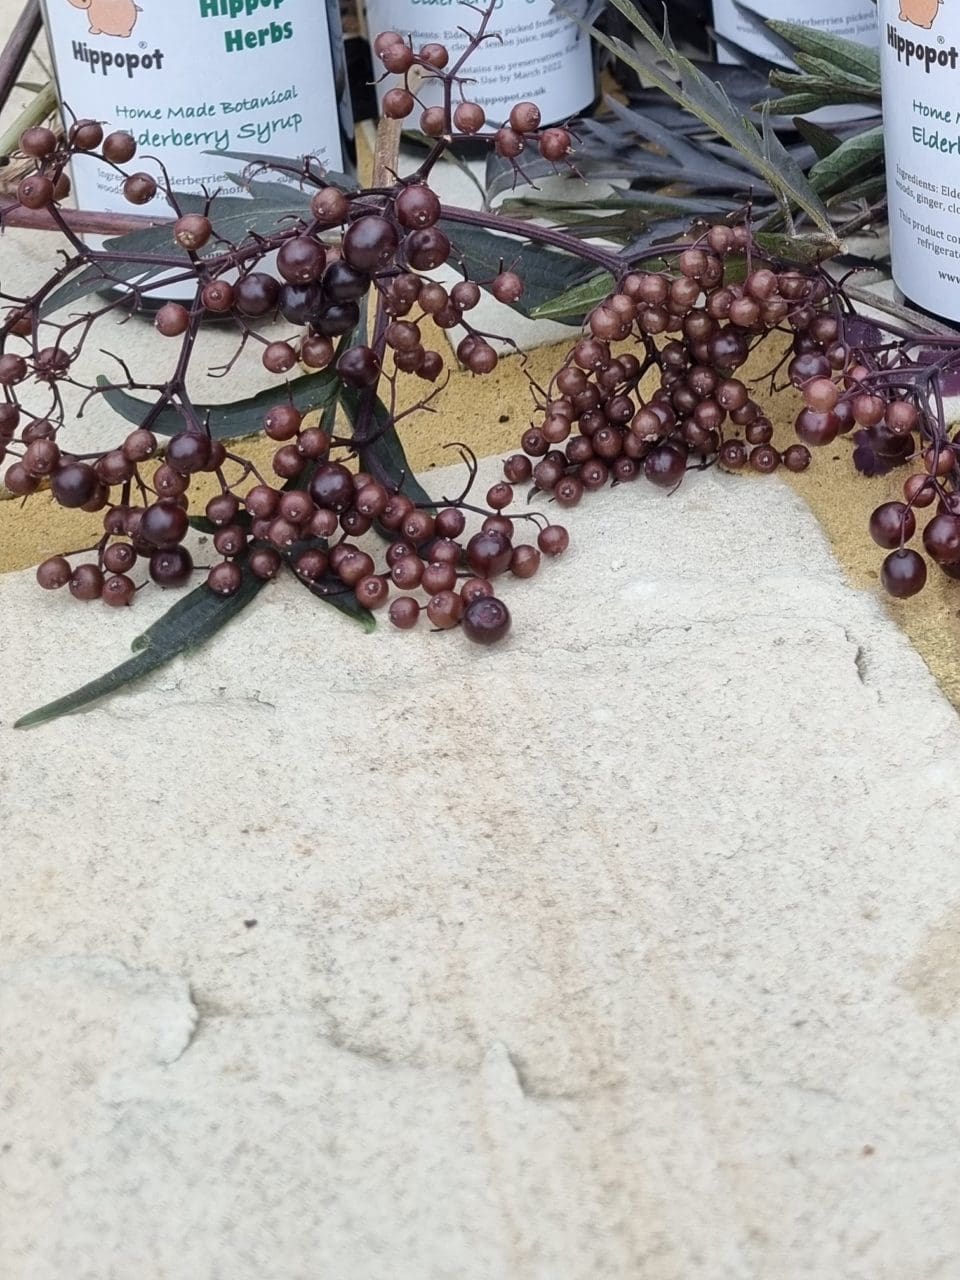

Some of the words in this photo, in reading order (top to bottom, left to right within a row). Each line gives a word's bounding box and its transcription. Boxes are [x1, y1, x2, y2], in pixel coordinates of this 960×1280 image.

[224, 21, 293, 52] Herbs
[886, 23, 959, 74] Hippopot
[72, 40, 164, 78] Hippopot
[116, 105, 162, 120] Home
[167, 102, 216, 119] Made
[220, 85, 298, 114] Botanical
[912, 99, 951, 122] Home
[117, 128, 229, 151] lderberry
[237, 112, 303, 144] Syrup
[896, 163, 939, 193] Ingredients:
[916, 193, 946, 212] ginger,
[912, 218, 945, 240] product
